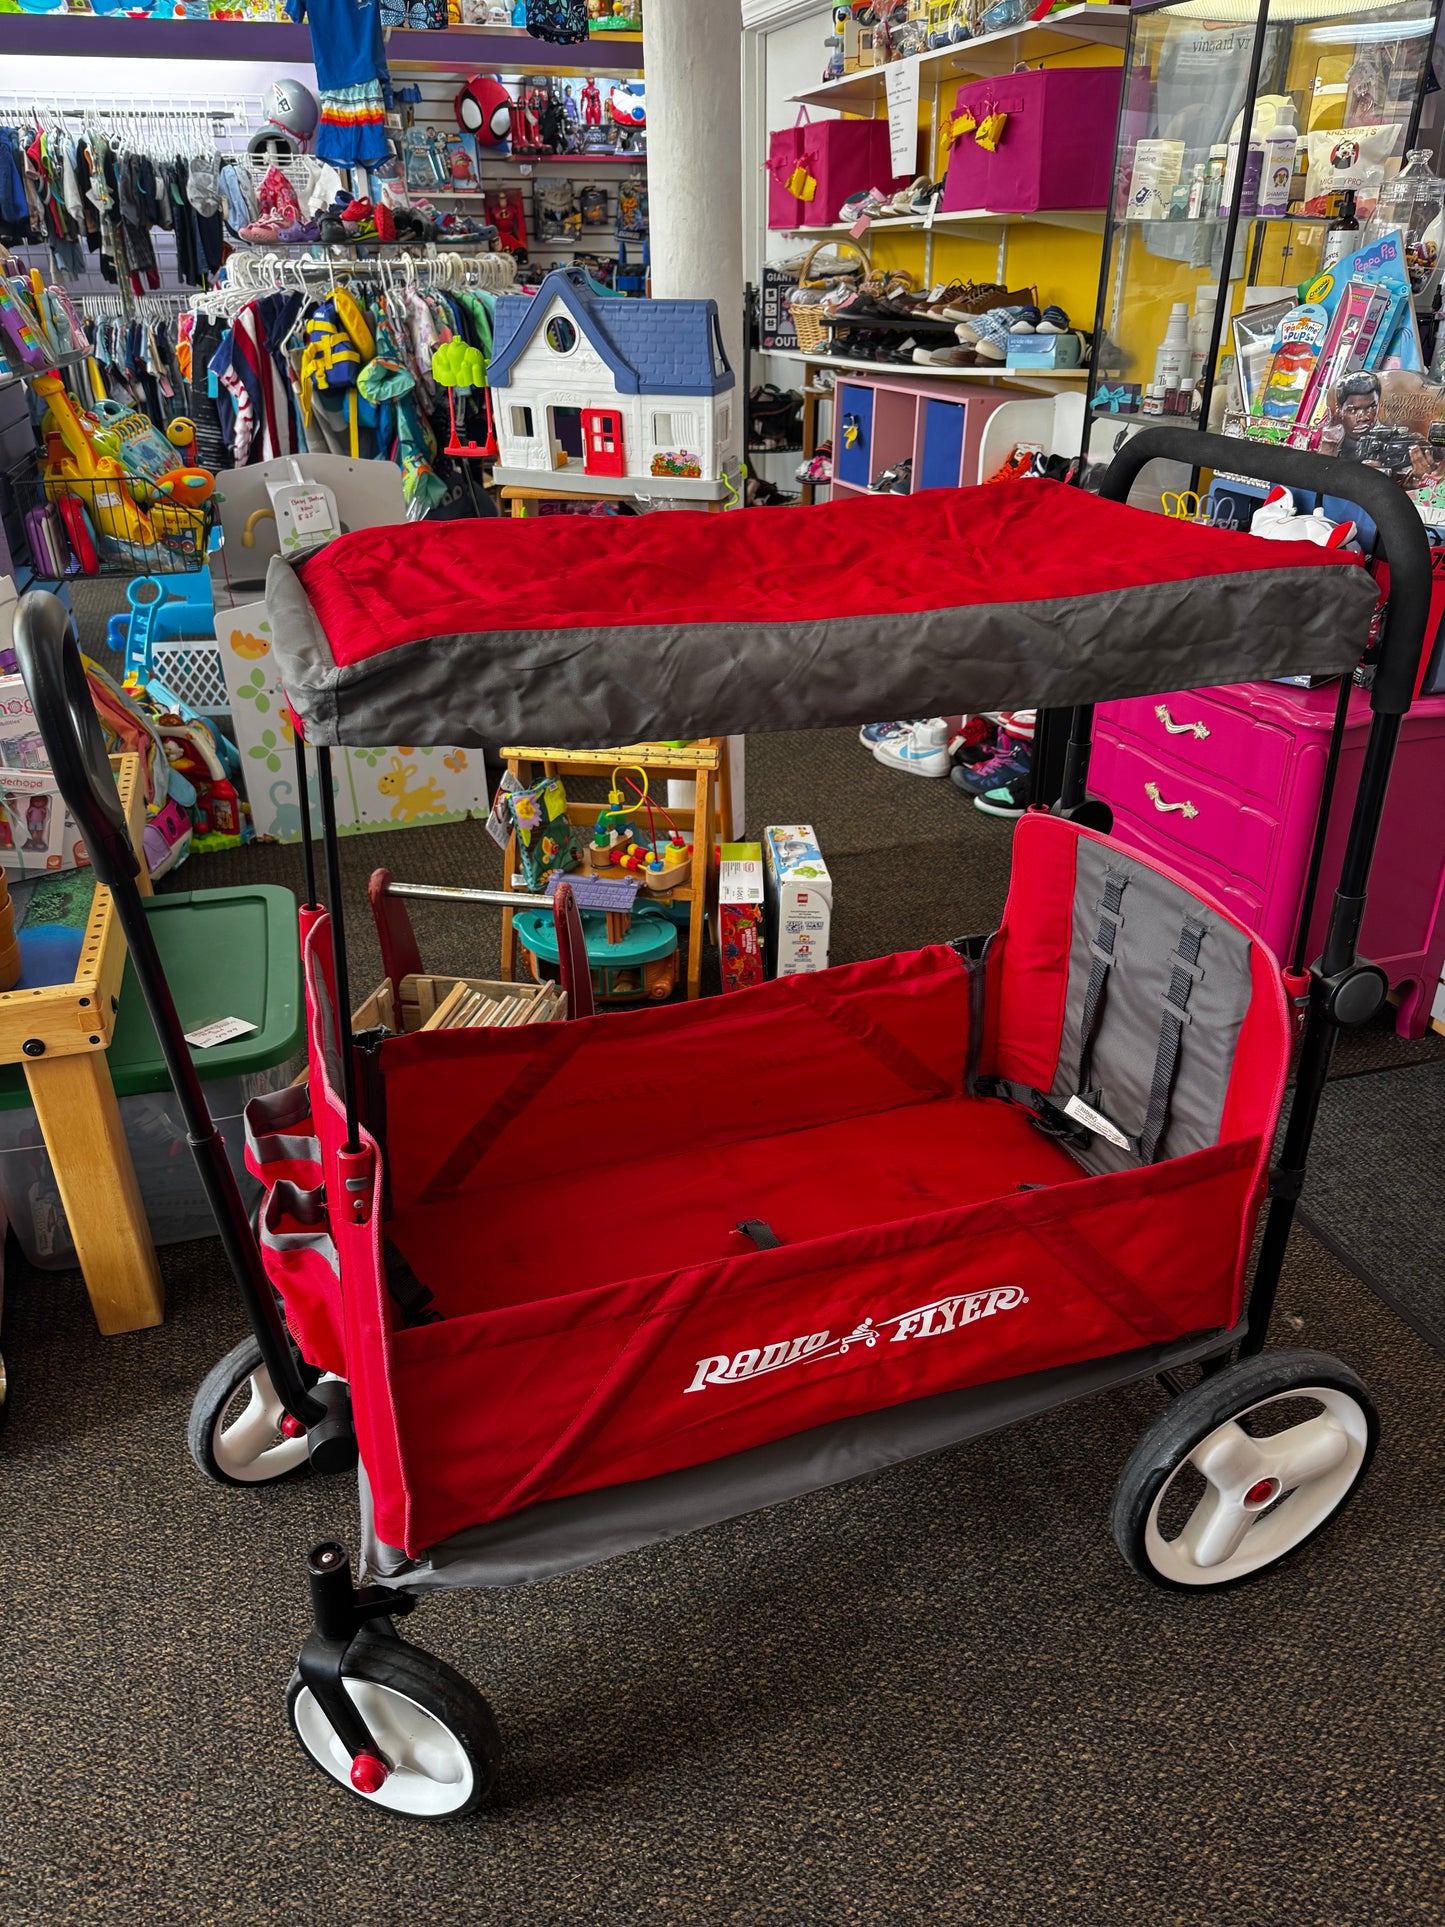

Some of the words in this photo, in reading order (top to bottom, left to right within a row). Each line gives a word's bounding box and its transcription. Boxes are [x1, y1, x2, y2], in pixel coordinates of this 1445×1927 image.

[1354, 257, 1381, 272] Peppa
[1381, 243, 1397, 259] Pig
[683, 1330, 830, 1394] RADIO
